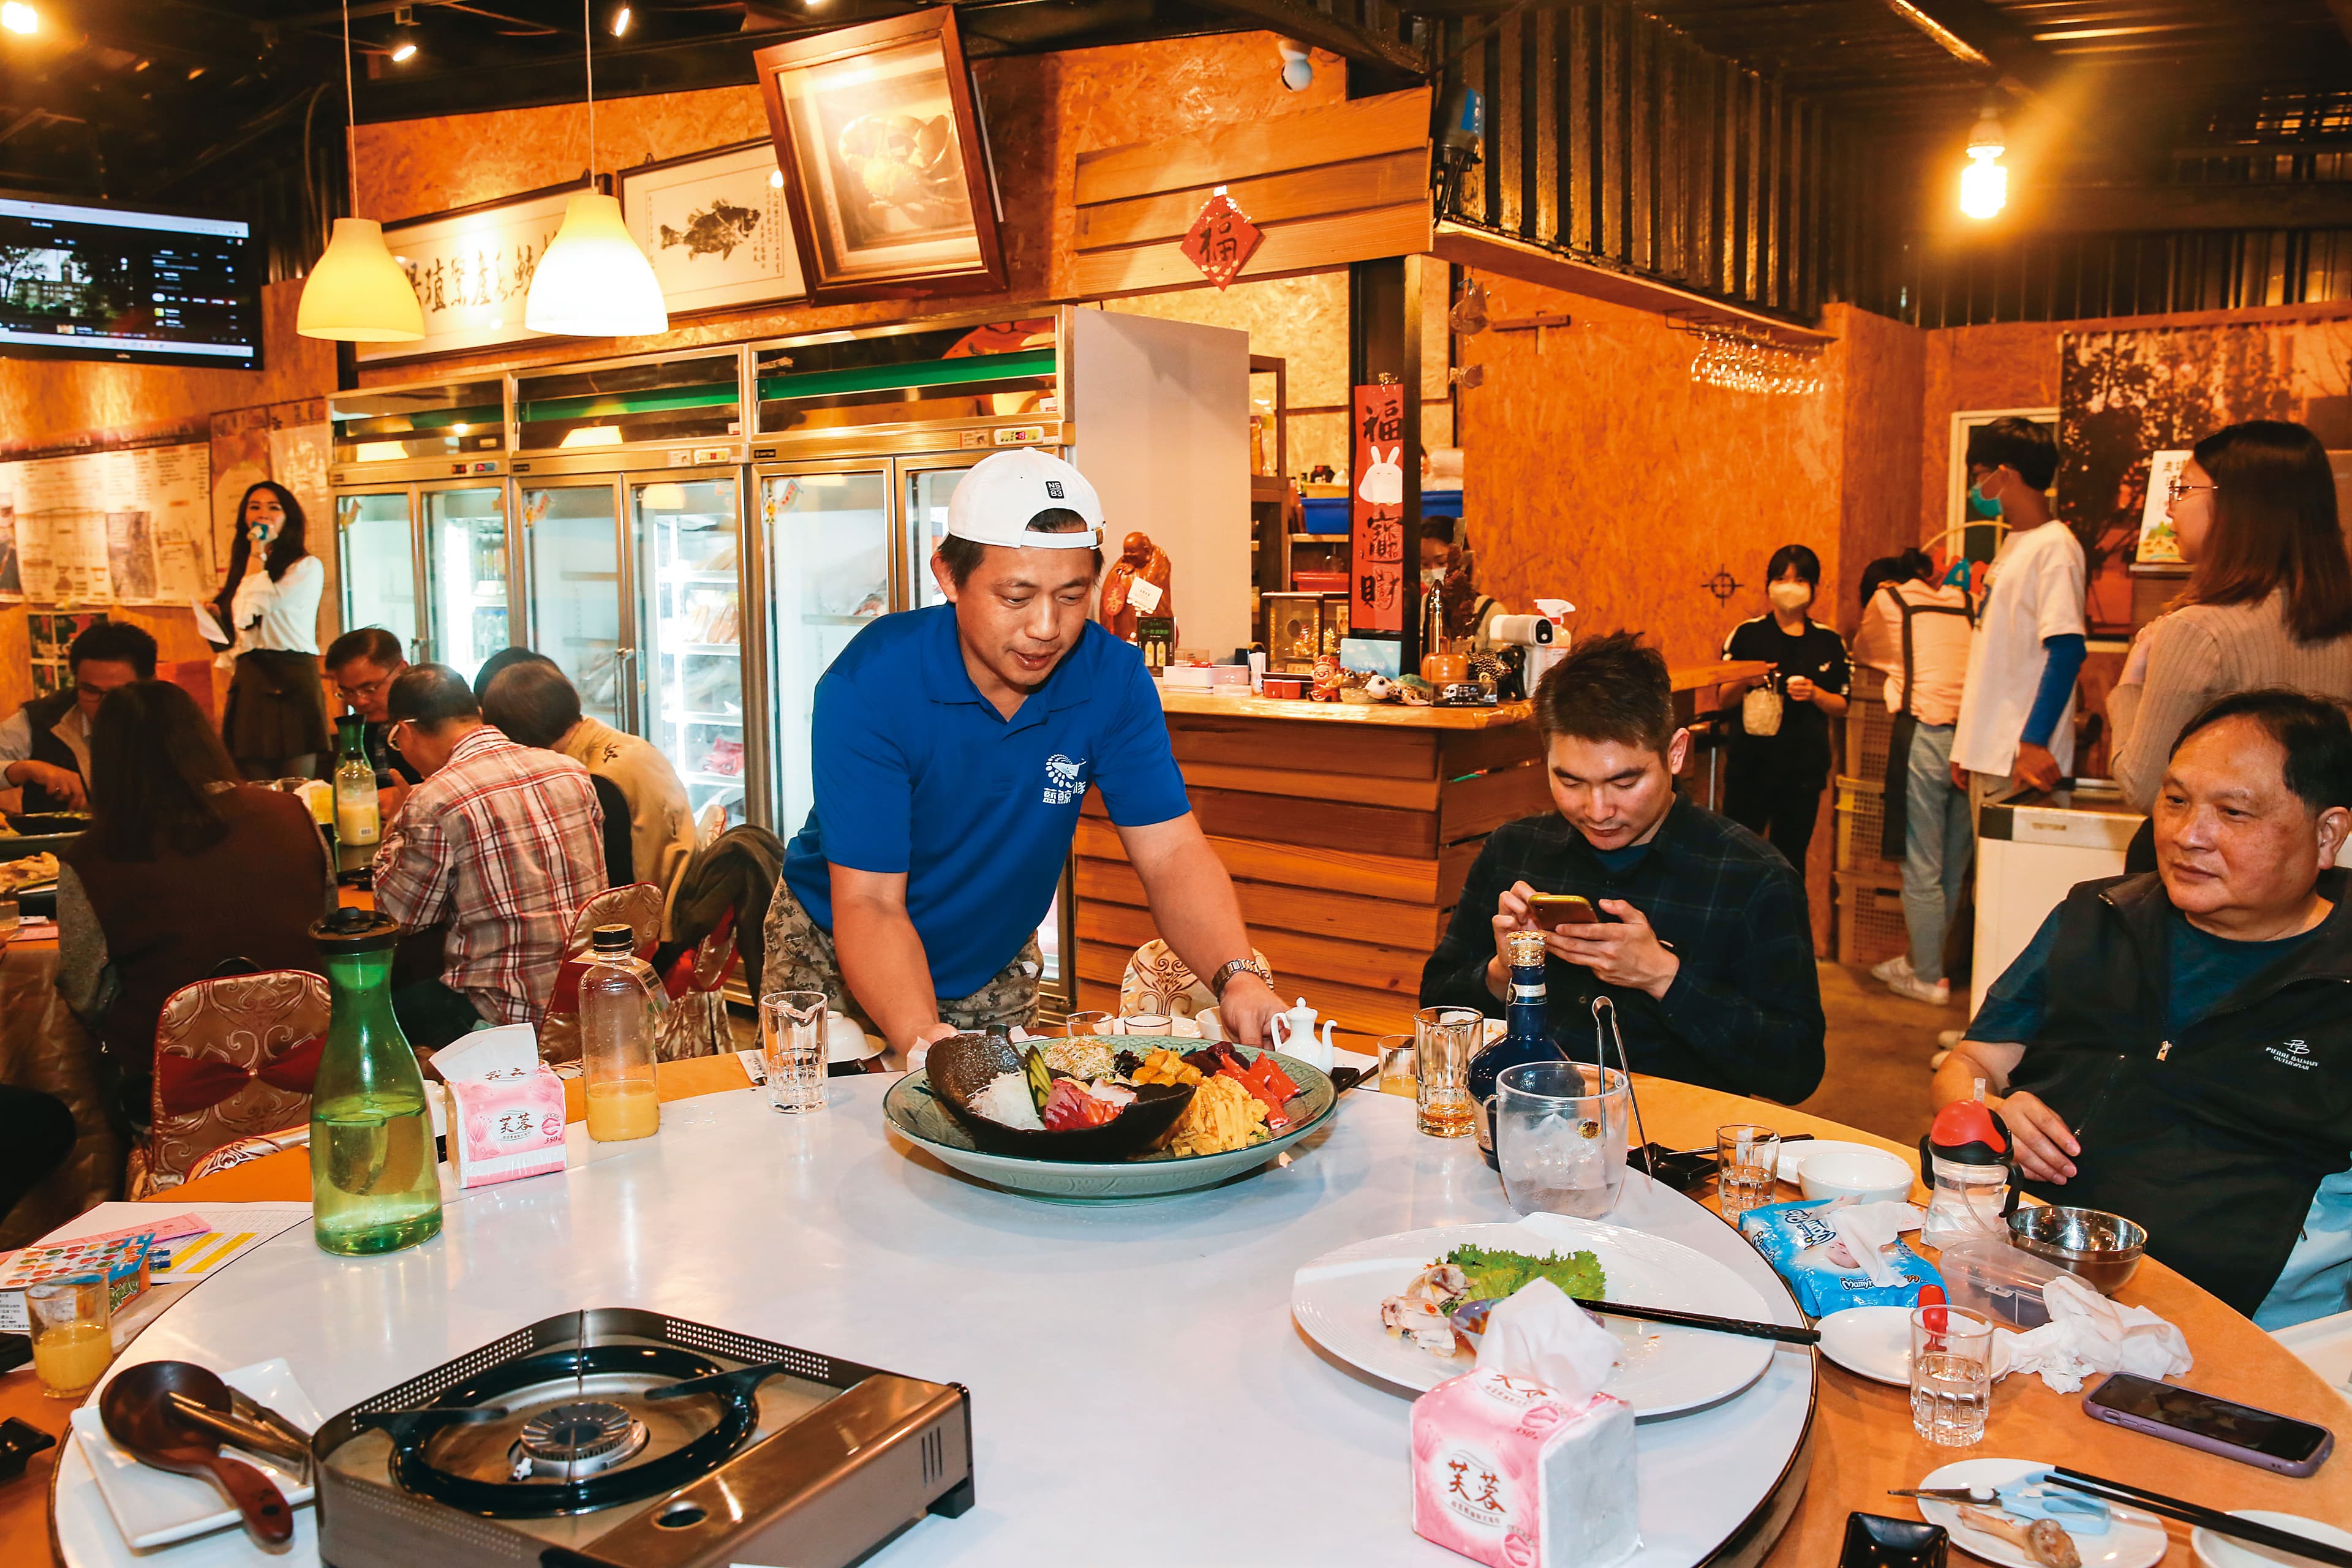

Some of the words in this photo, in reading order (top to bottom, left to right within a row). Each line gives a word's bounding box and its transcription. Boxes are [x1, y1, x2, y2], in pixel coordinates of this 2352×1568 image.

[1199, 211, 1237, 262] 福
[1362, 399, 1403, 442] 福
[2266, 1047, 2290, 1060] PIERRE
[2291, 1055, 2318, 1067] BALMAIN
[2273, 1055, 2309, 1071] OUTERWEAR
[499, 1112, 534, 1134] 芙蓉
[1448, 1459, 1506, 1513] 芙蓉
